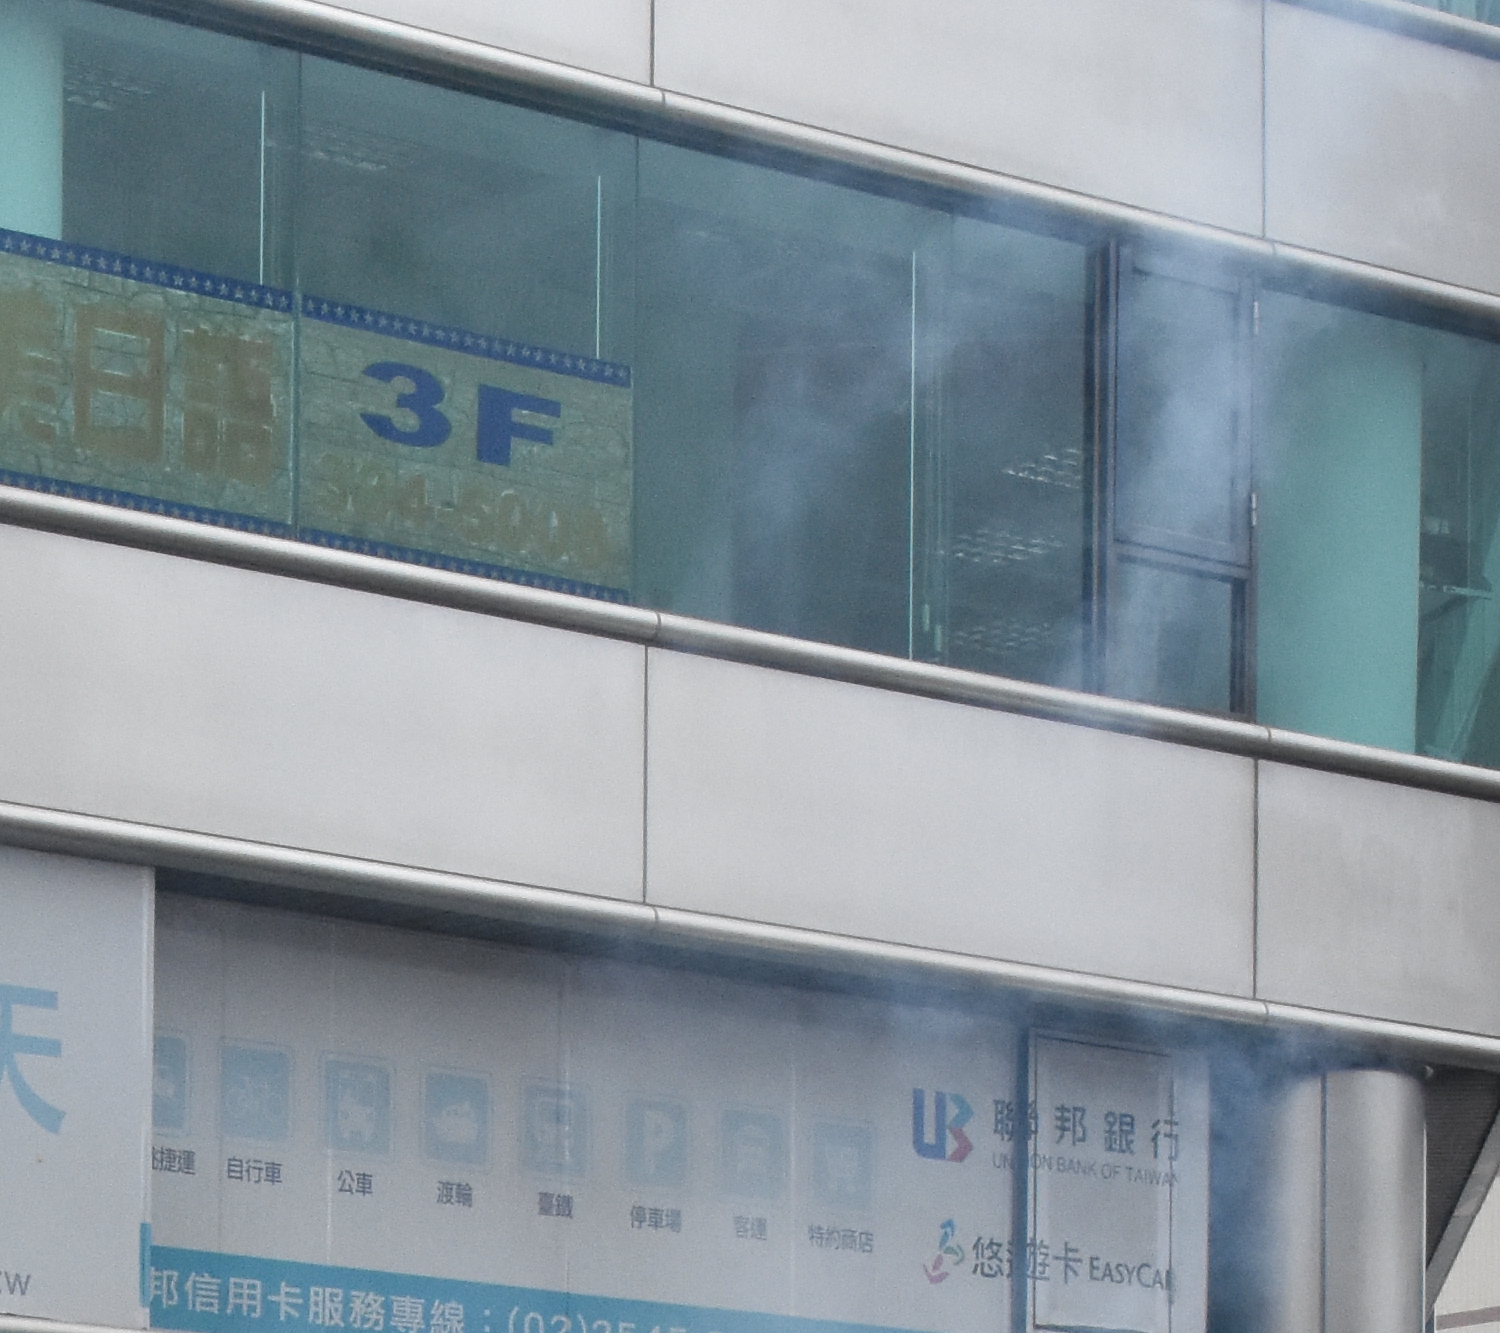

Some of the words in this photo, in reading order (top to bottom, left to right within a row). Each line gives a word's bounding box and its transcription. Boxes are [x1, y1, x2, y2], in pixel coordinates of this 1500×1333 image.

[360, 361, 562, 468] 3F
[227, 1156, 283, 1185] 自行車
[338, 1170, 373, 1196] 公車
[1057, 1157, 1096, 1176] BANK
[1101, 1163, 1121, 1180] OF
